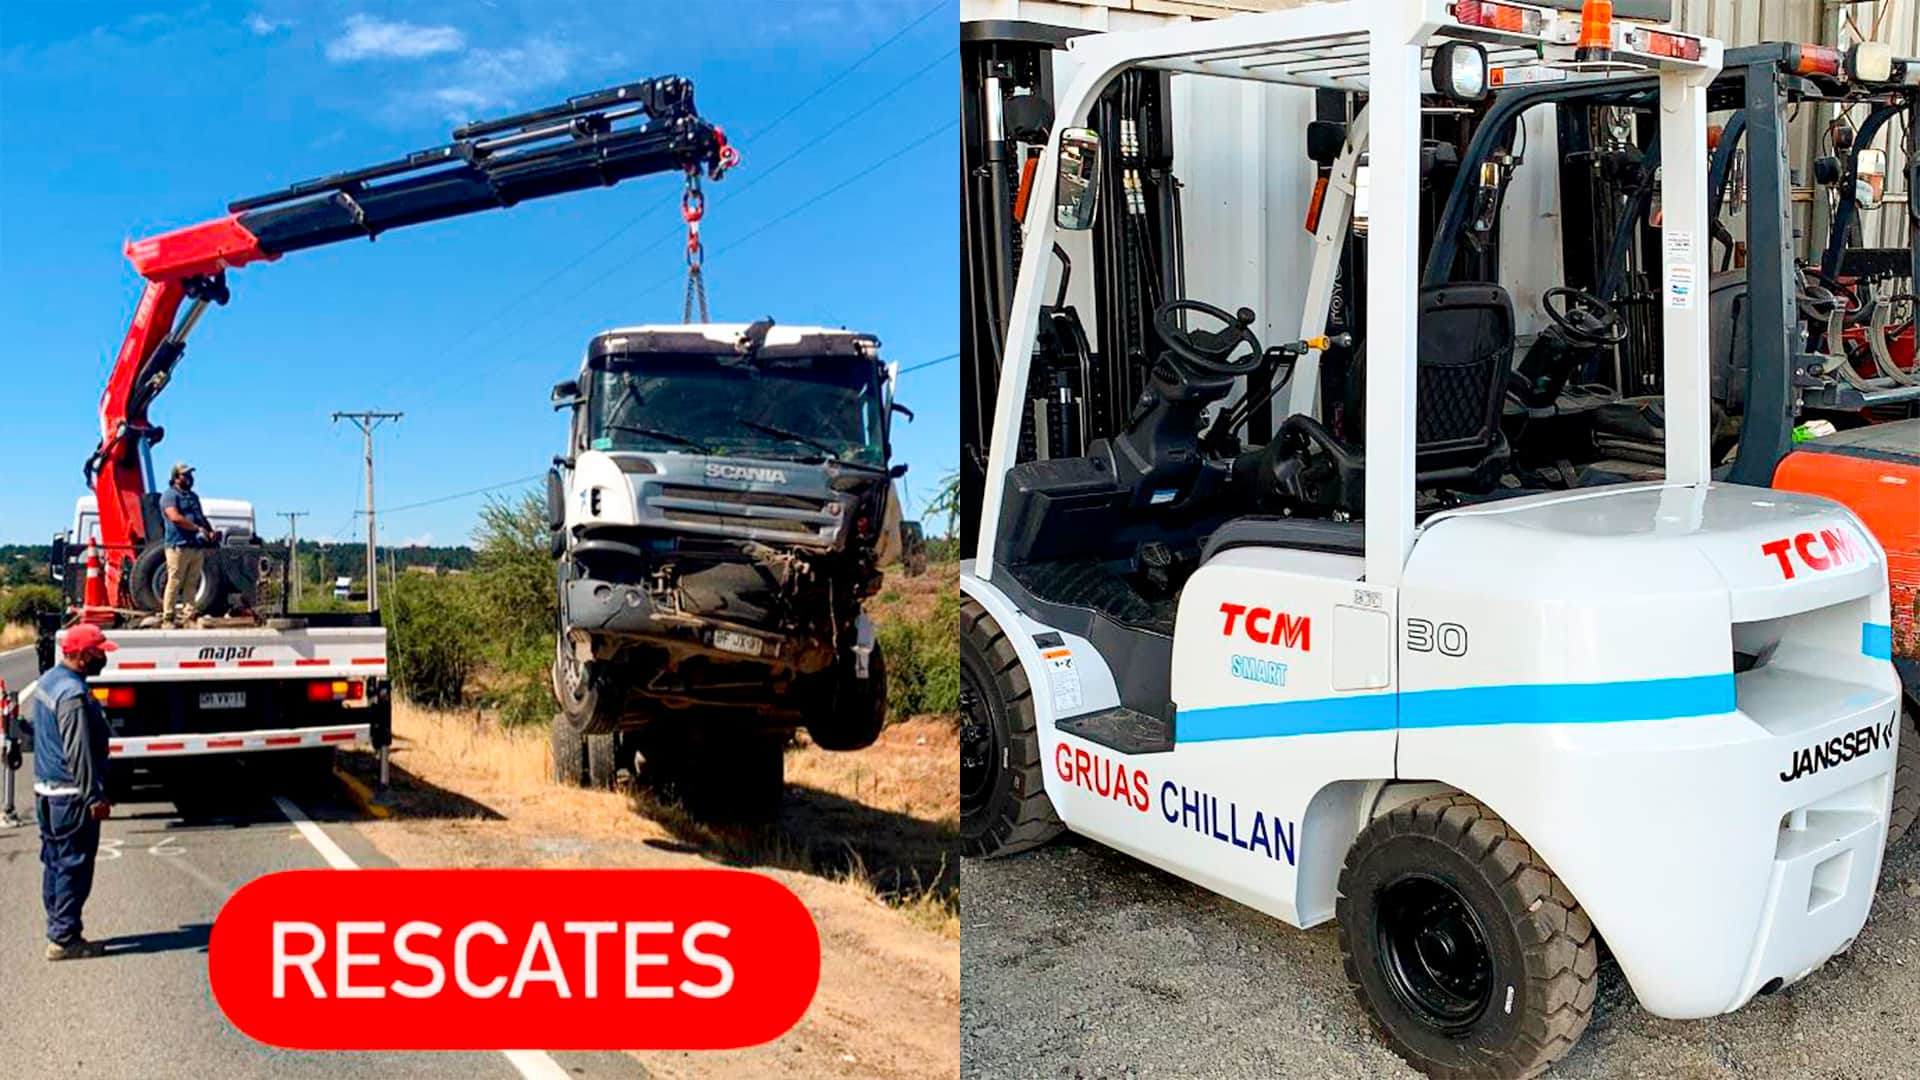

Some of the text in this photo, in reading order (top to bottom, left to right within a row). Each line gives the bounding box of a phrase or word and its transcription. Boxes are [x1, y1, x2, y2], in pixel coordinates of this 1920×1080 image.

[1330, 263, 1344, 325] TOYO
[706, 463, 786, 483] SCANIA
[1761, 527, 1866, 580] TCM
[1219, 602, 1311, 652] TCM
[1407, 618, 1468, 657] 30
[198, 646, 256, 662] mapar
[1231, 655, 1288, 687] SMART
[1779, 723, 1881, 782] JANSSEN
[1055, 742, 1295, 866] GRUAS CHILLAN
